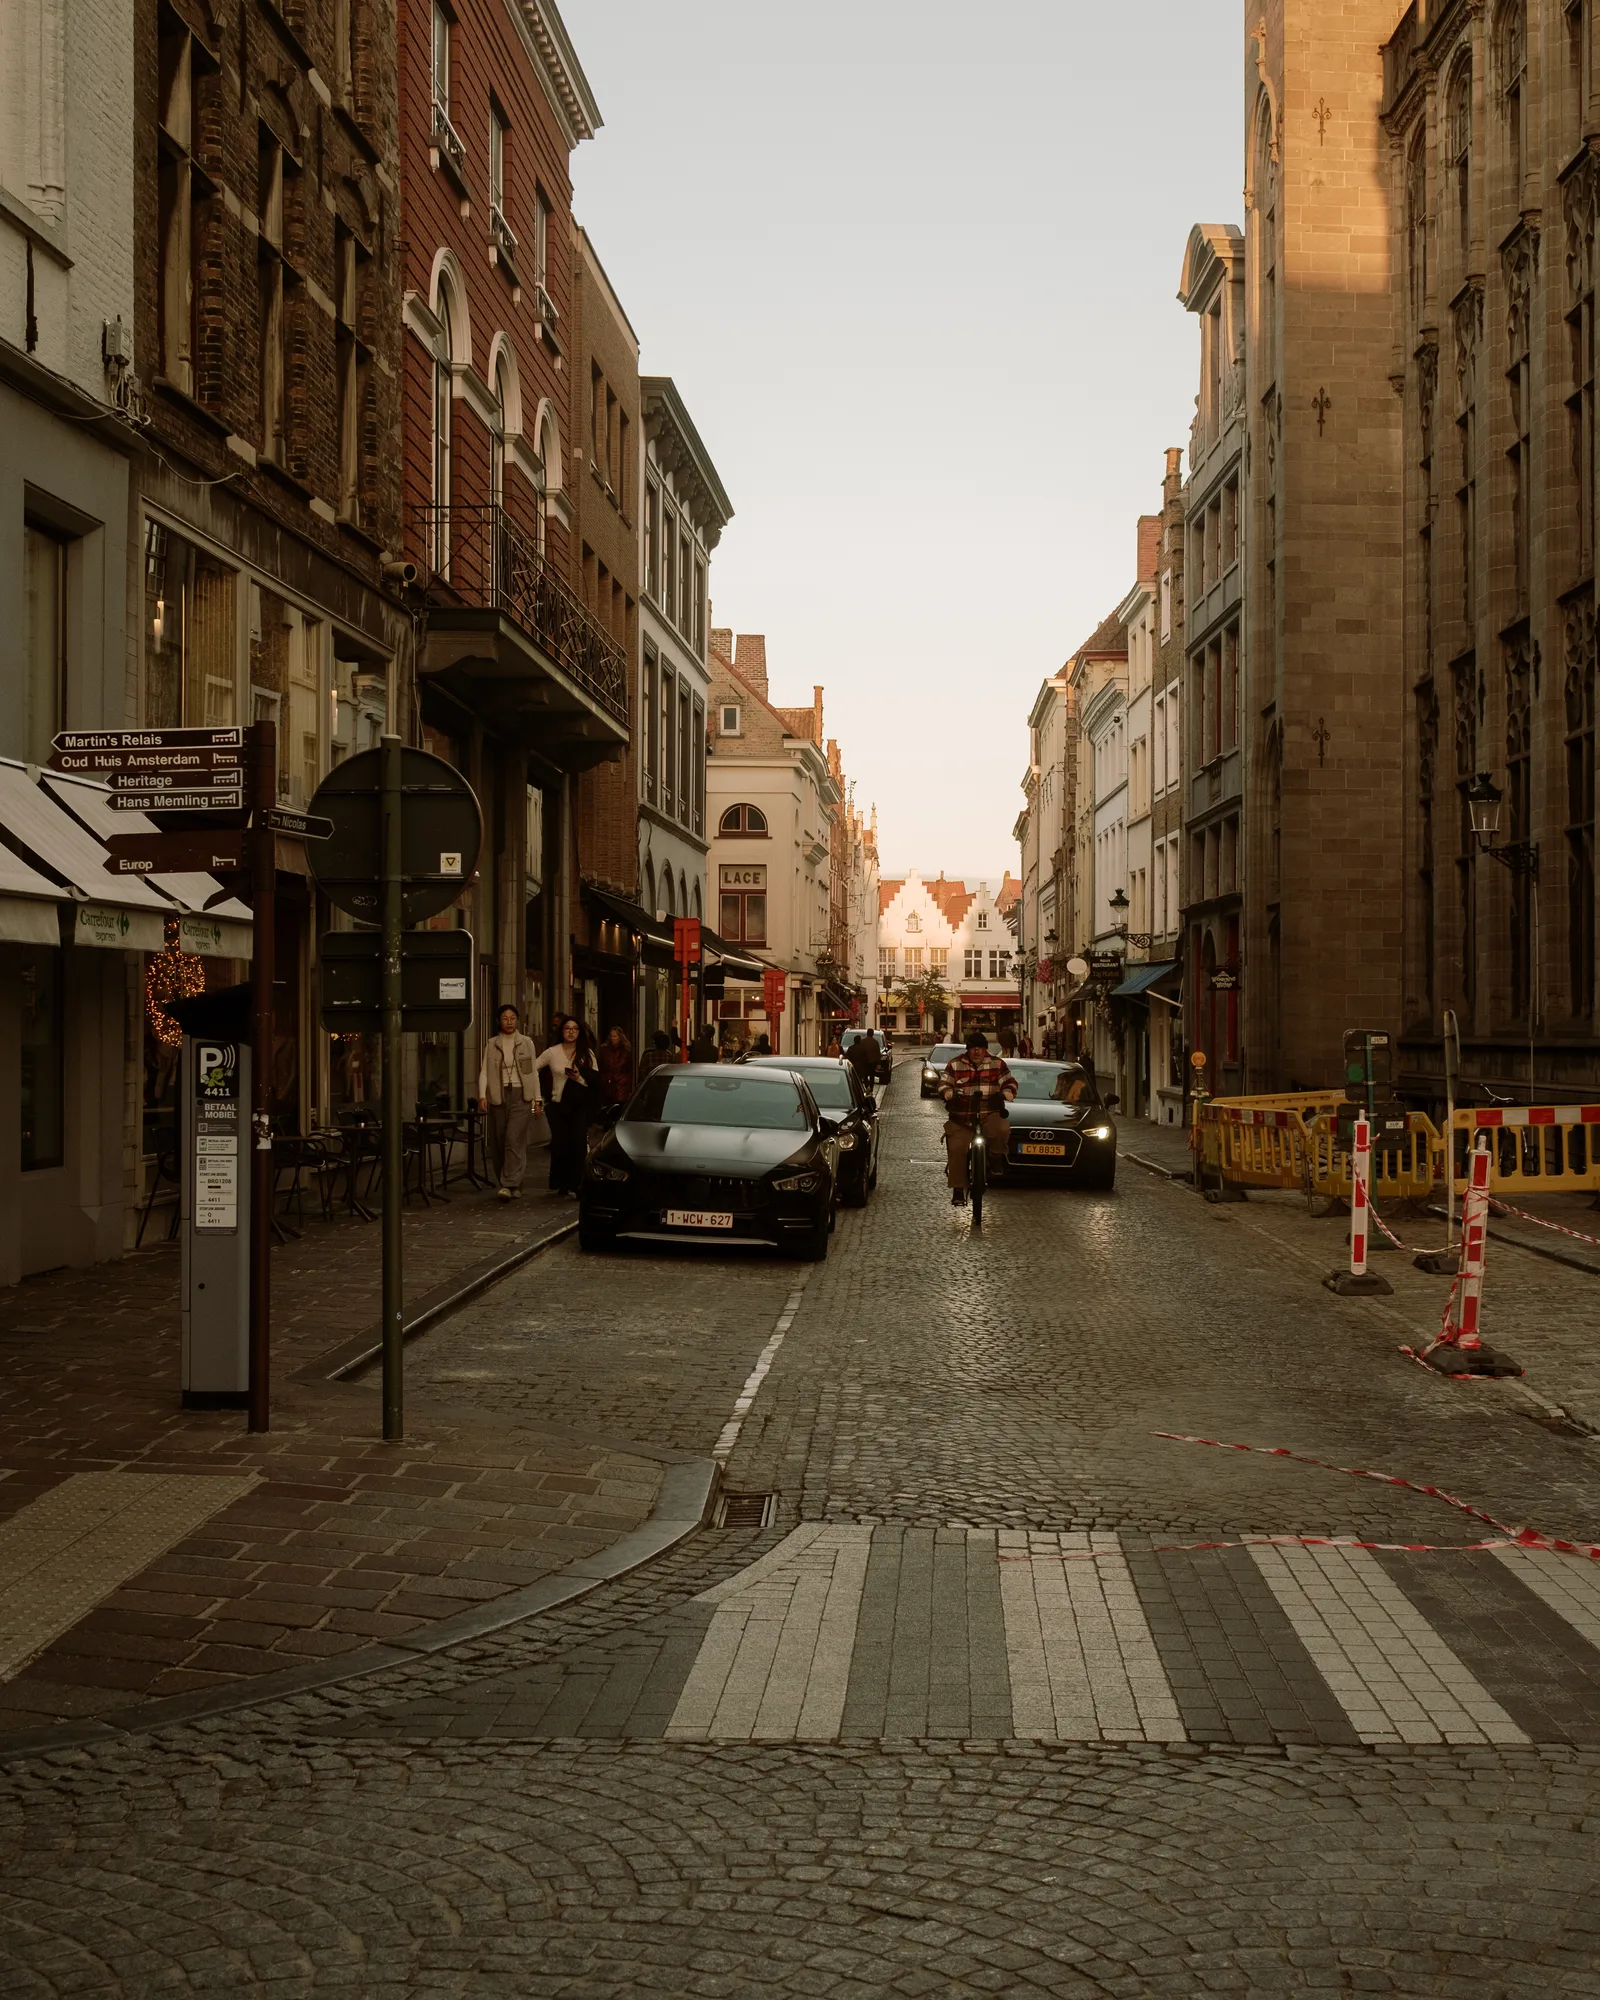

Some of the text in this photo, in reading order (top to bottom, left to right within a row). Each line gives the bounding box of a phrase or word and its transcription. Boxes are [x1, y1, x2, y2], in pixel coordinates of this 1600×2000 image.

[65, 733, 163, 748] Martin's Relais
[61, 754, 201, 769] Oud Huis Amsterdam
[117, 774, 173, 789] Heritage
[117, 793, 209, 809] Hans Memling
[281, 815, 307, 831] Nicolas
[119, 859, 154, 872] Europ
[724, 872, 761, 885] LACE
[80, 908, 115, 929] Carrefour
[182, 920, 210, 939] Carrefour
[200, 1047, 224, 1084] P
[204, 1087, 231, 1097] 4411
[204, 1103, 237, 1111] BETAAL
[205, 1111, 237, 1119] MOBIEL
[1026, 1145, 1061, 1155] CY 8835
[669, 1211, 732, 1227] 1-WCW-627
